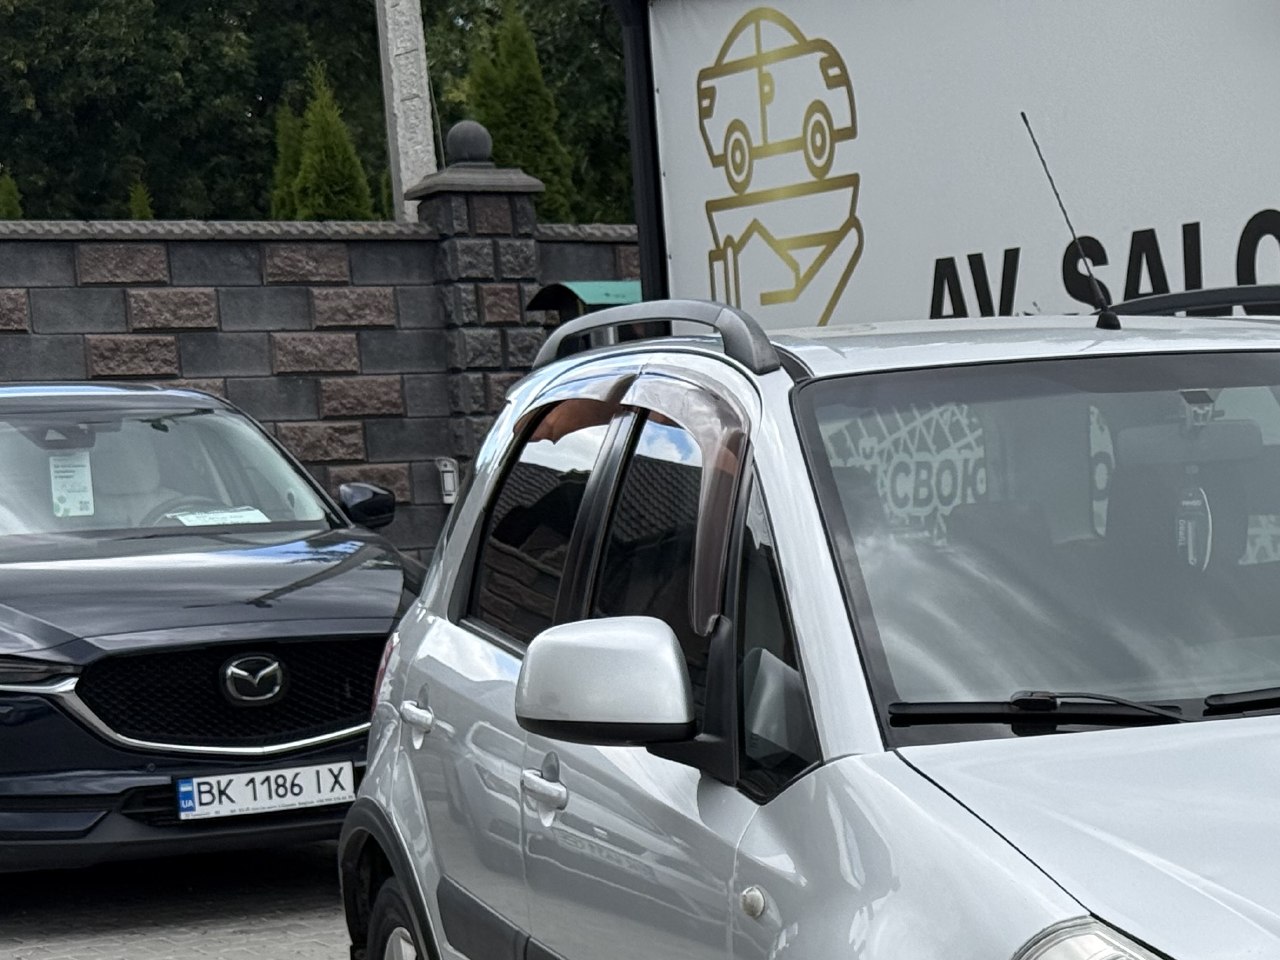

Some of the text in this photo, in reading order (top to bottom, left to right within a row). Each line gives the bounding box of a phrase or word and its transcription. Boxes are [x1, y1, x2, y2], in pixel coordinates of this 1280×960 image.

[197, 779, 236, 807] BK
[245, 772, 304, 802] 1186
[315, 766, 346, 794] IX
[181, 800, 194, 809] UA
